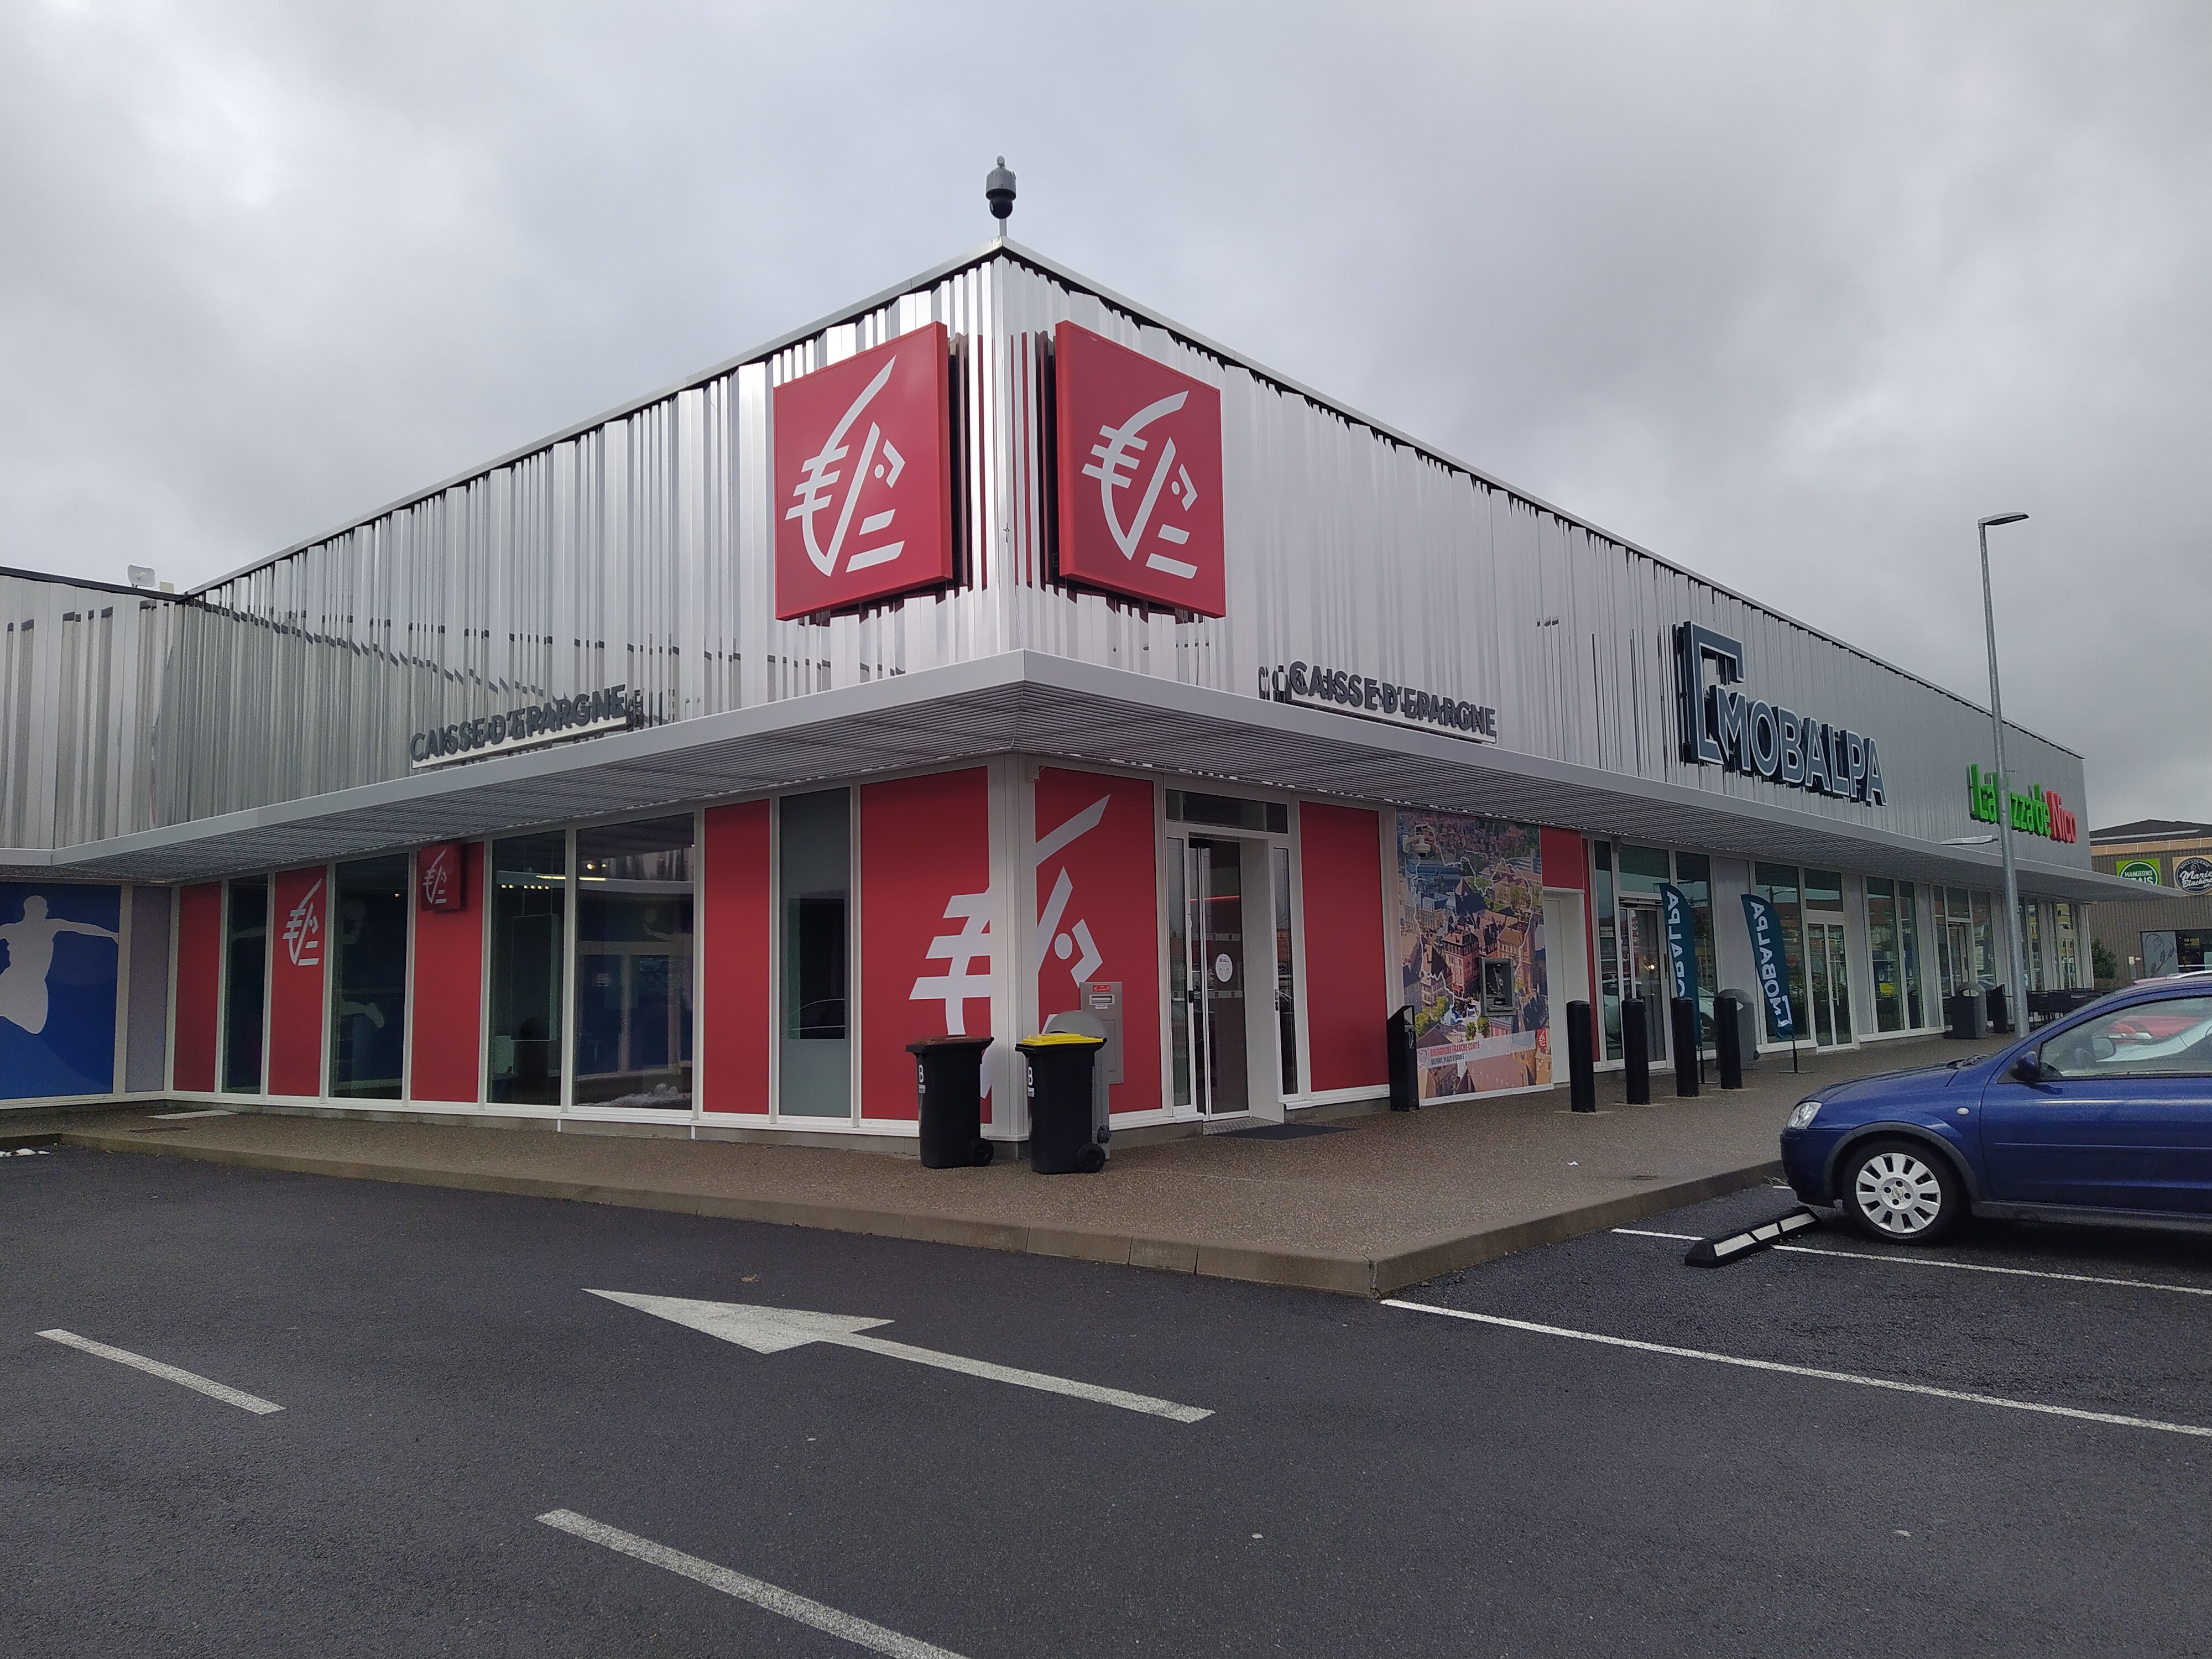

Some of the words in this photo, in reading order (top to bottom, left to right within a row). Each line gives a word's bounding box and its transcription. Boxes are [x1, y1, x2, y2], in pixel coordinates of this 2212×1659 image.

[410, 717, 485, 761] CAISSE
[491, 684, 626, 744] D'EPARGNE
[1289, 661, 1378, 710] CAISSE
[1383, 682, 1497, 736] D'EPARGNE
[1709, 684, 1887, 806] MOBALPA
[1970, 764, 1997, 822] La
[2033, 784, 2051, 837] de
[2046, 790, 2077, 843] Nico
[919, 1065, 924, 1083] B
[1027, 1066, 1033, 1086] B
